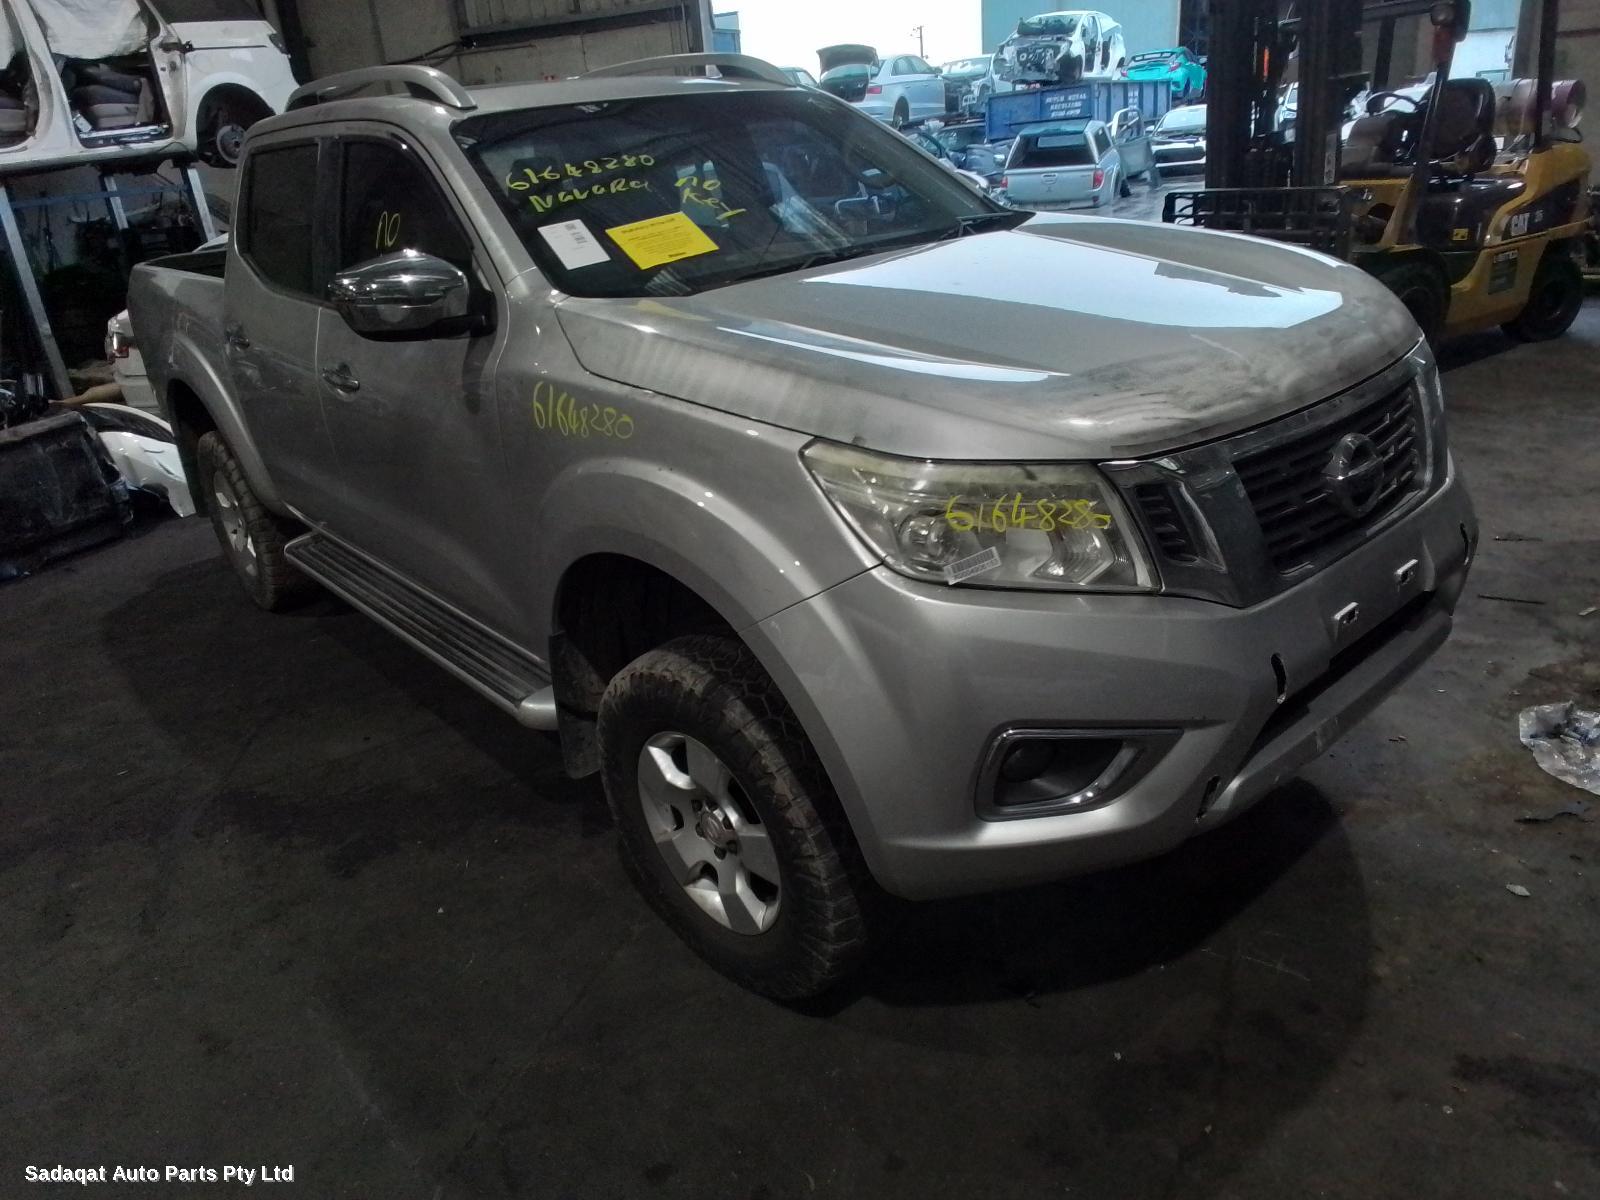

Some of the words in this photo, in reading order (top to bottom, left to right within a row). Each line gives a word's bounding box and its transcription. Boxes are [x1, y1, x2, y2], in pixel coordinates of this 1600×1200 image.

[505, 154, 655, 191] 61648280
[1511, 212, 1530, 237] CAT
[532, 381, 635, 439] 61648280
